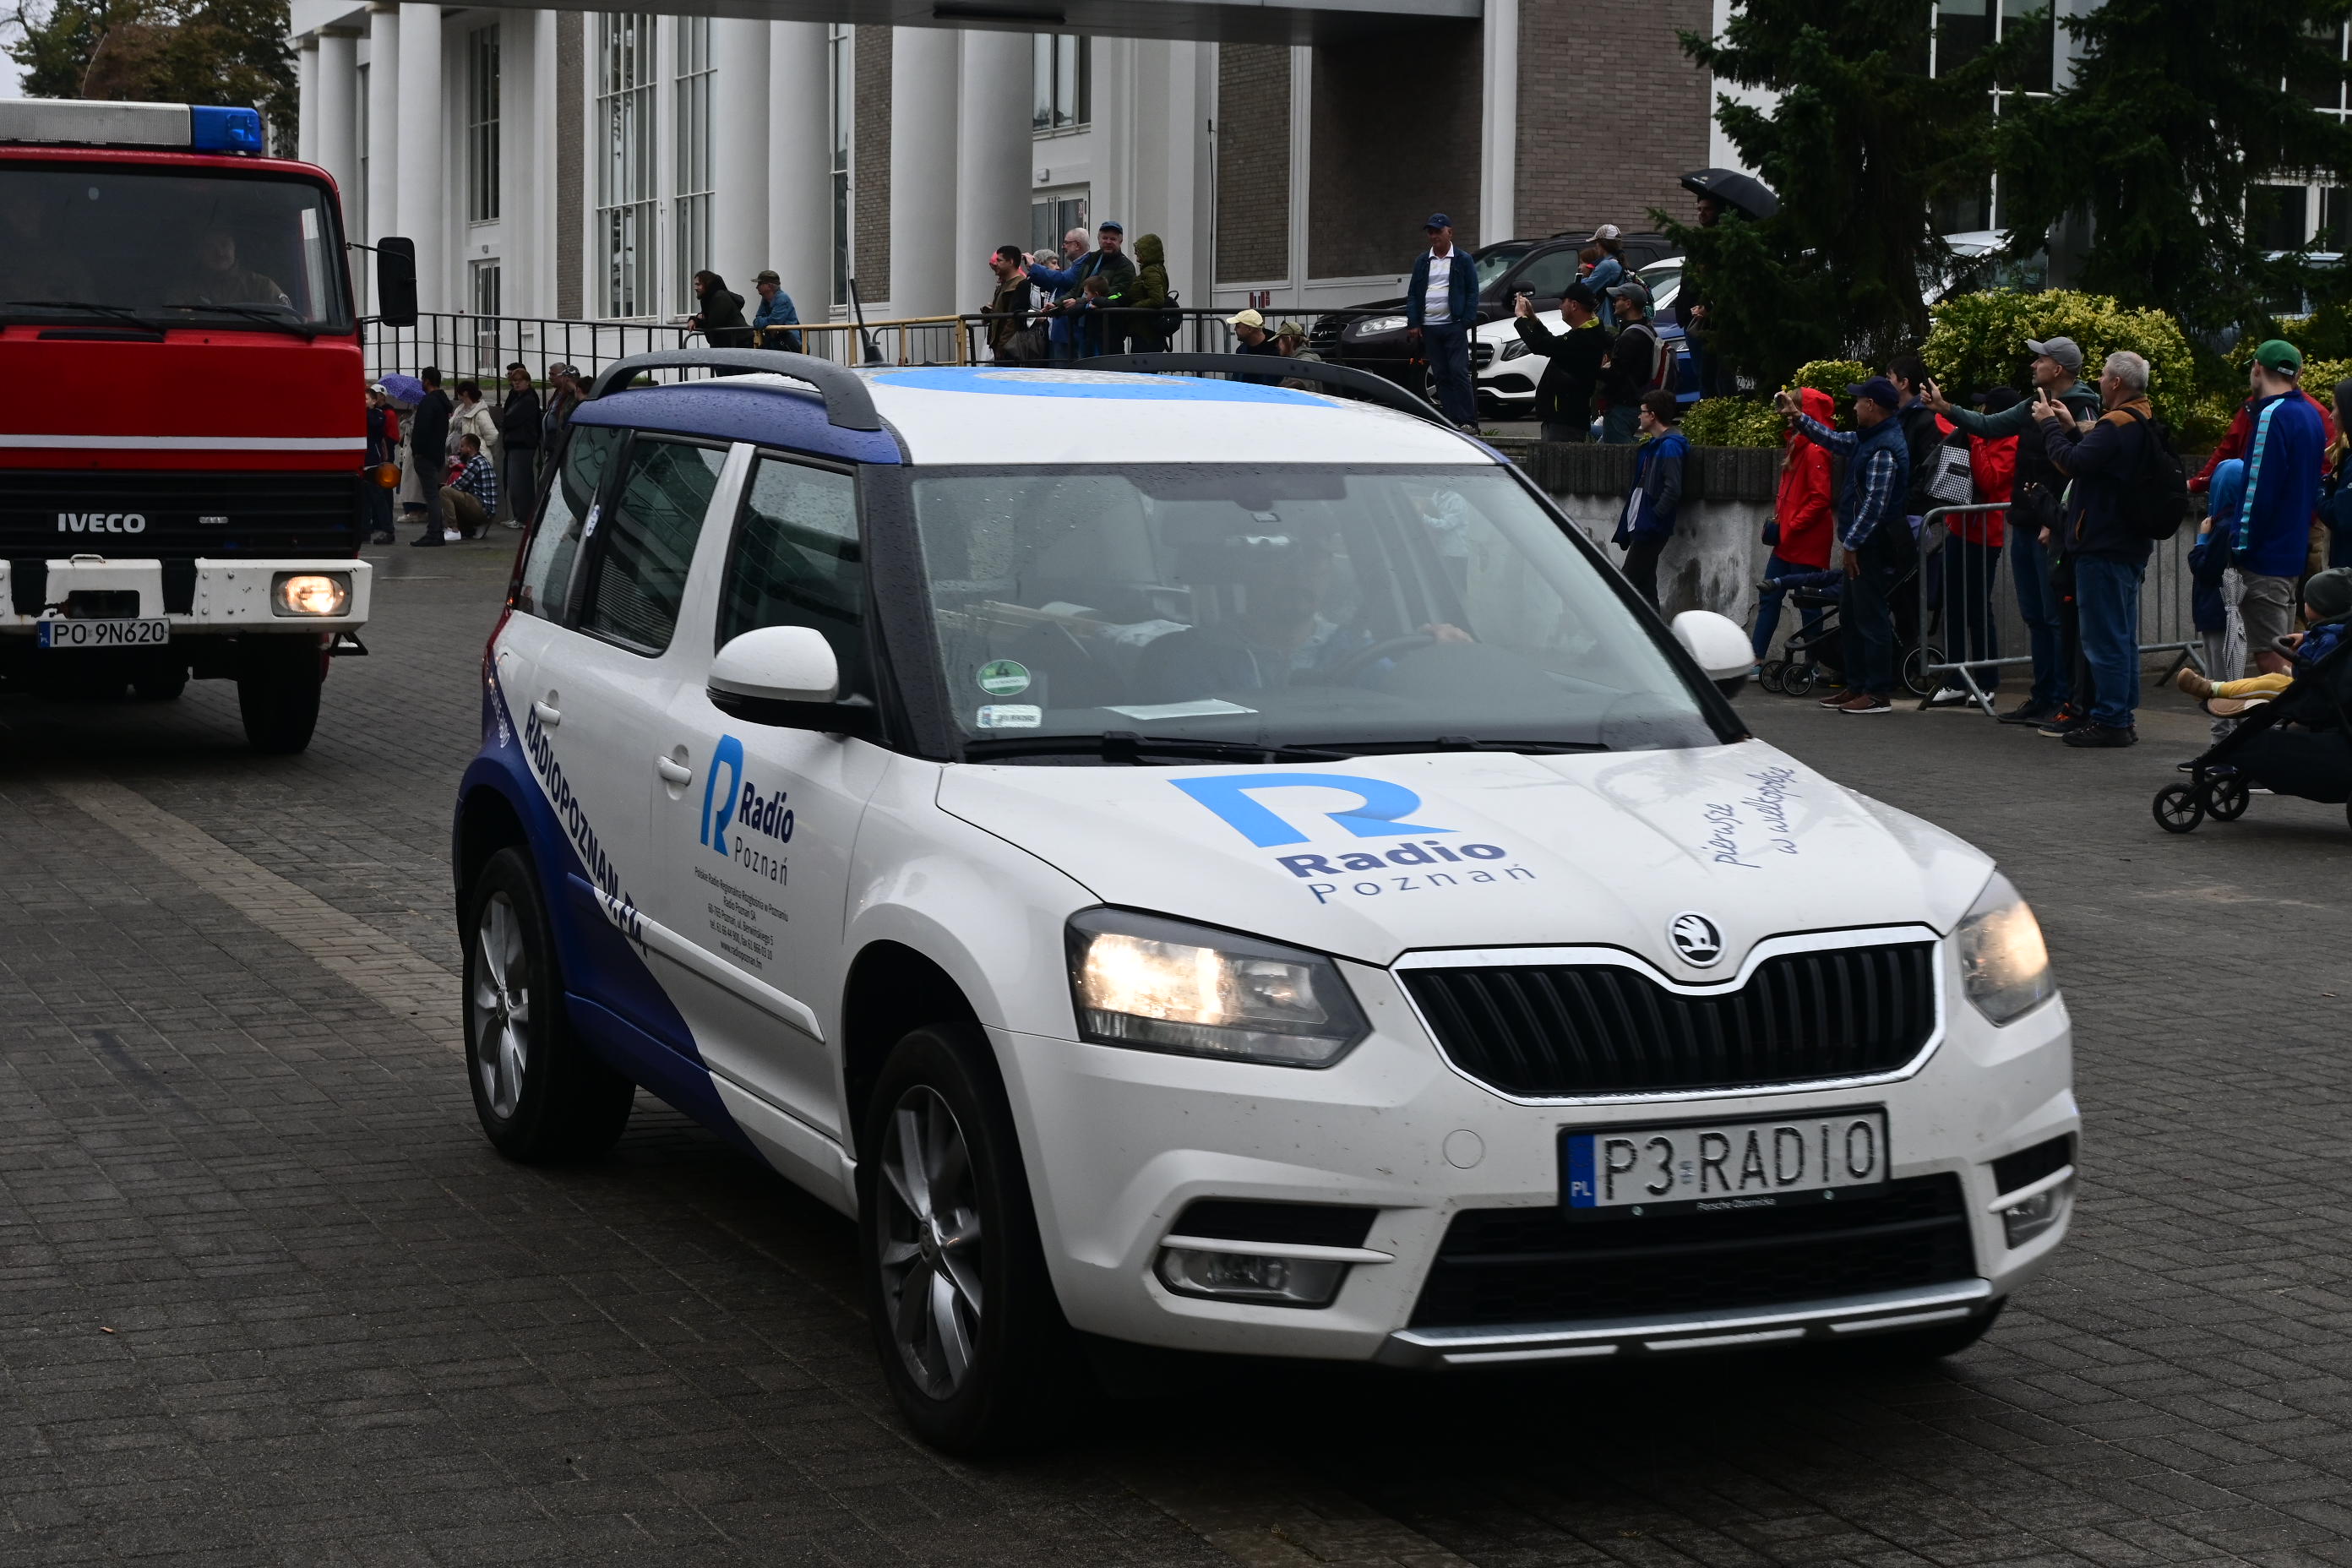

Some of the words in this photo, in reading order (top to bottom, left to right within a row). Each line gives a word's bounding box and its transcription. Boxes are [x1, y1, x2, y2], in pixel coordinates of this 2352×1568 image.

[57, 513, 146, 533] IVECO
[54, 623, 86, 645] PO
[95, 622, 165, 644] 9N620
[738, 781, 795, 843] Radio
[1701, 803, 1762, 868] pierwsze
[1770, 838, 1798, 854] w
[735, 836, 788, 885] Poznań
[1276, 840, 1507, 879] Radio
[1308, 863, 1537, 904] Poznań
[1605, 1135, 1674, 1200] P3
[1698, 1119, 1874, 1193] RADIO
[1571, 1181, 1592, 1197] PL
